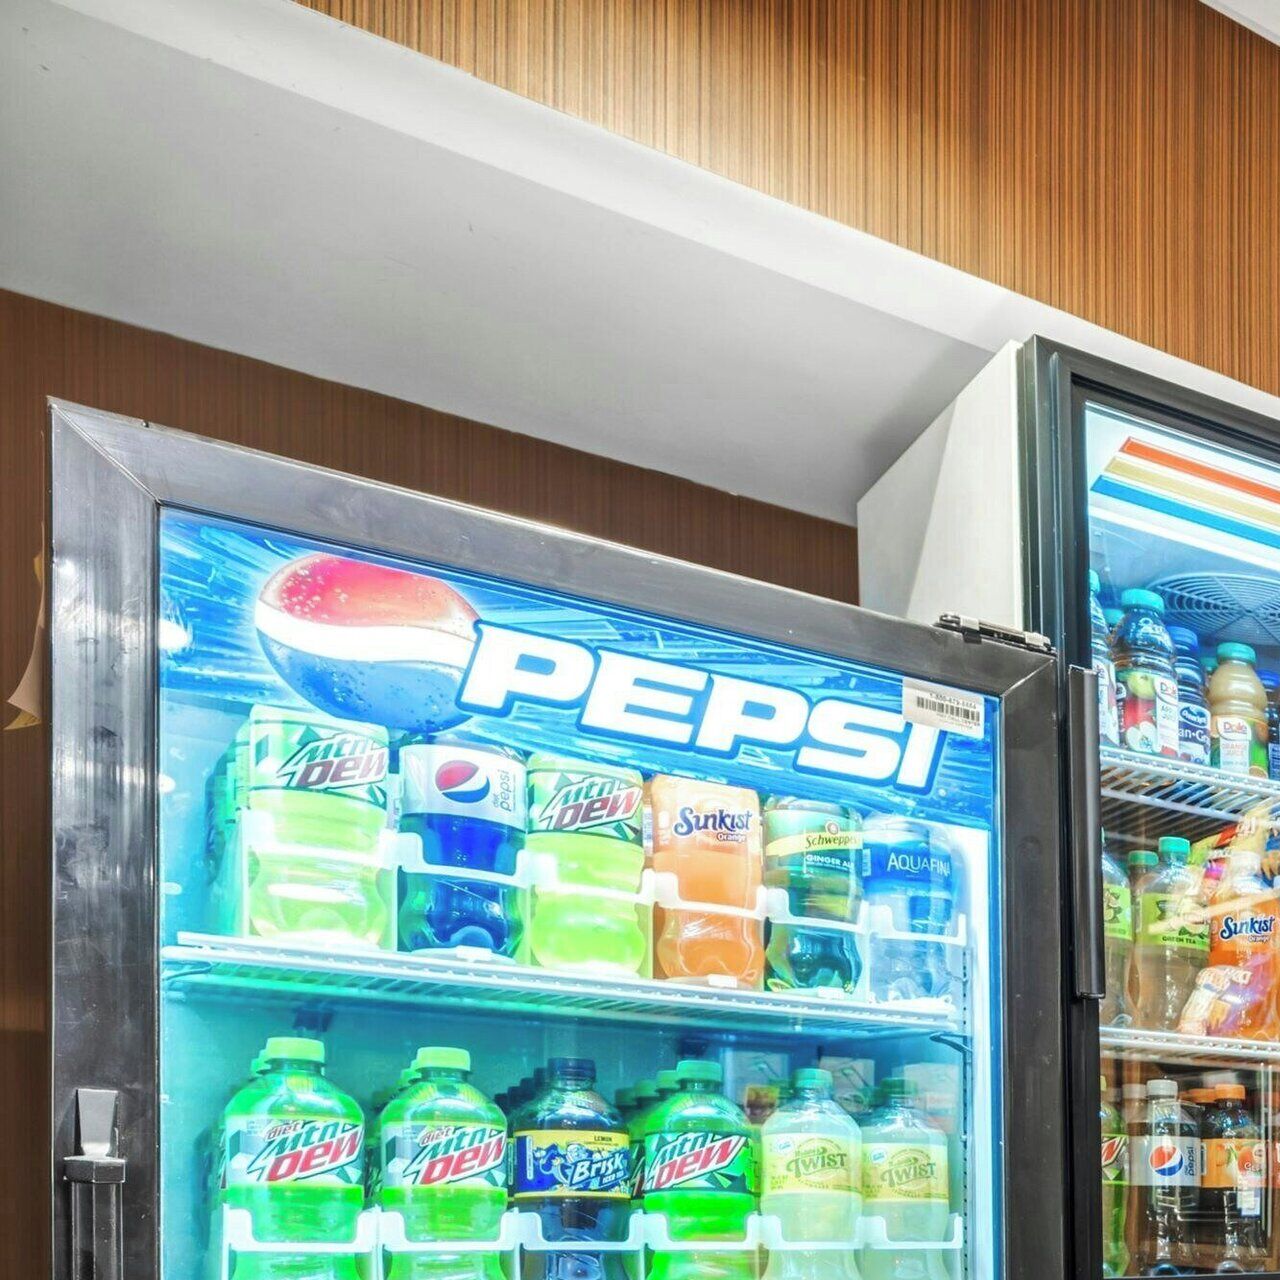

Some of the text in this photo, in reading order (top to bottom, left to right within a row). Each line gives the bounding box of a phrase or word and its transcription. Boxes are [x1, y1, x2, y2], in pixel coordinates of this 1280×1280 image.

[460, 626, 938, 788] PEPSI
[673, 807, 754, 837] Sunkist
[716, 832, 748, 843] Orange
[887, 851, 952, 878] AQUAFINA
[1219, 915, 1275, 941] Sunkist
[571, 1151, 624, 1189] Brisk
